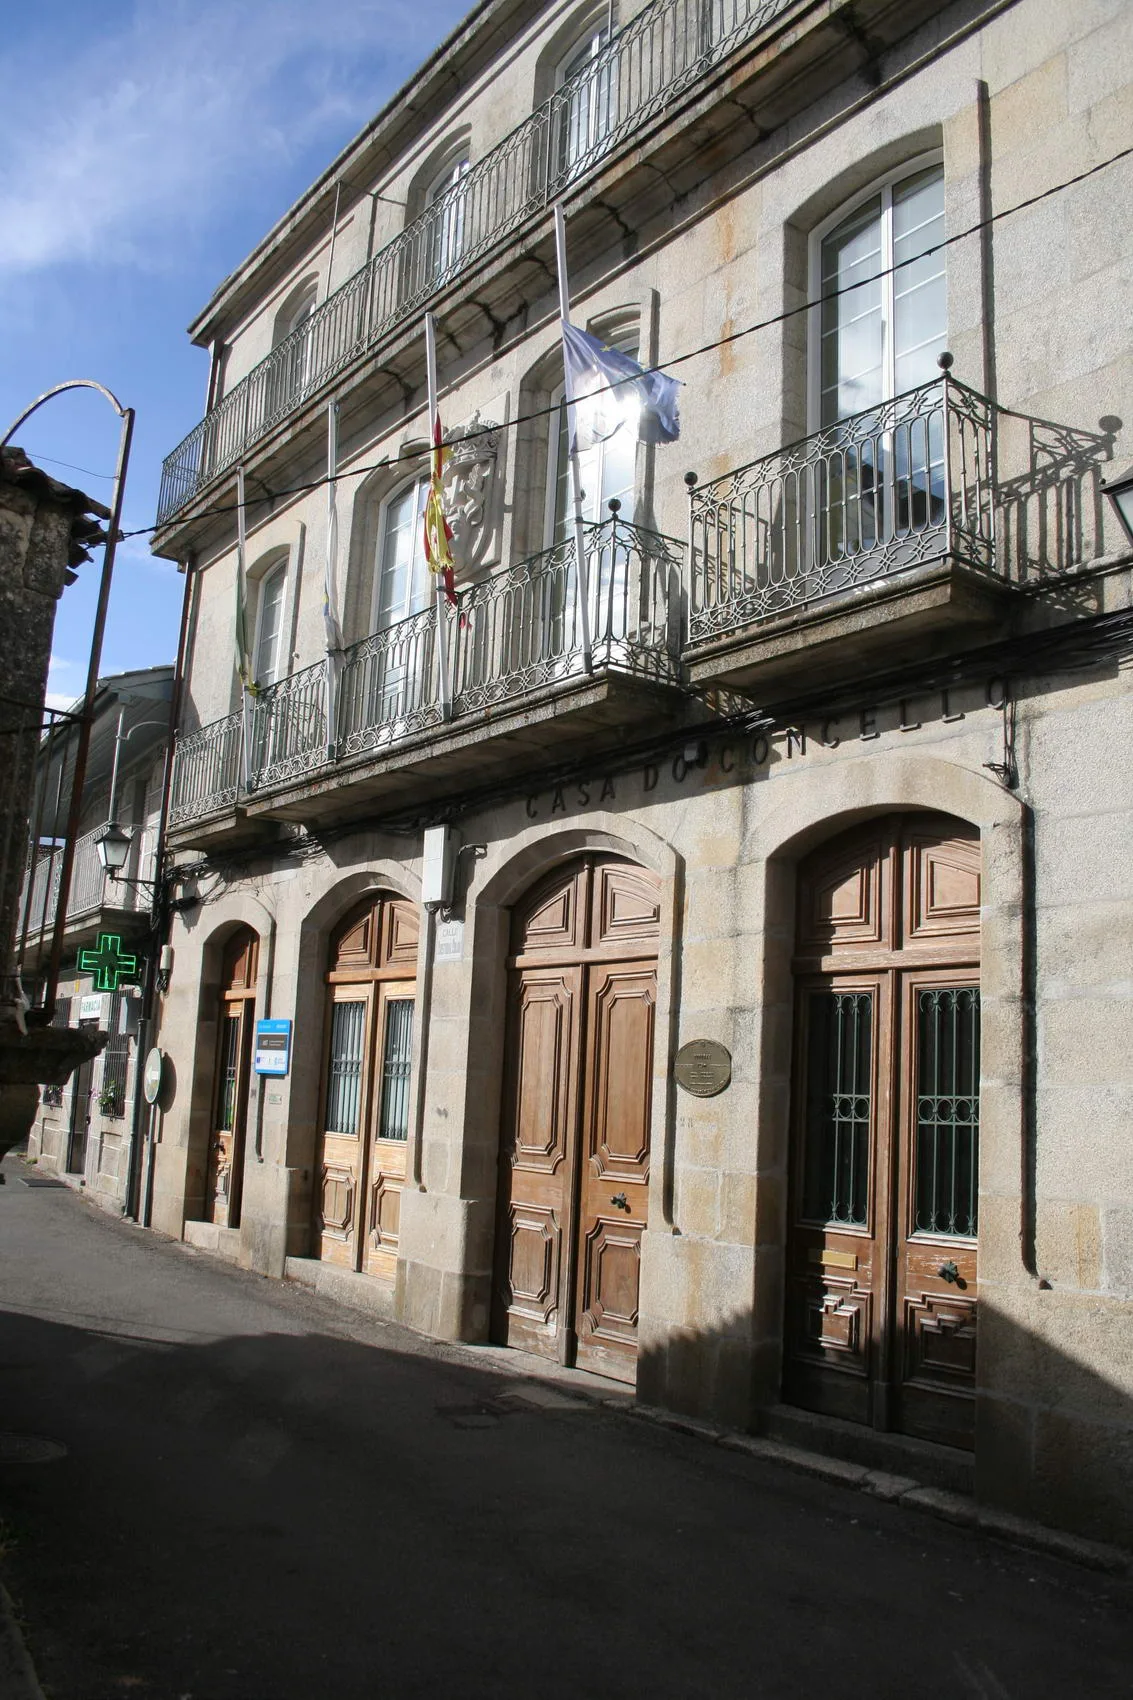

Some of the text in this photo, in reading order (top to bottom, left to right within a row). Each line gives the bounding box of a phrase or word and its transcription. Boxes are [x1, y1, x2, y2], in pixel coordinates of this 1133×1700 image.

[526, 675, 1010, 819] CASA DO CONCELLO
